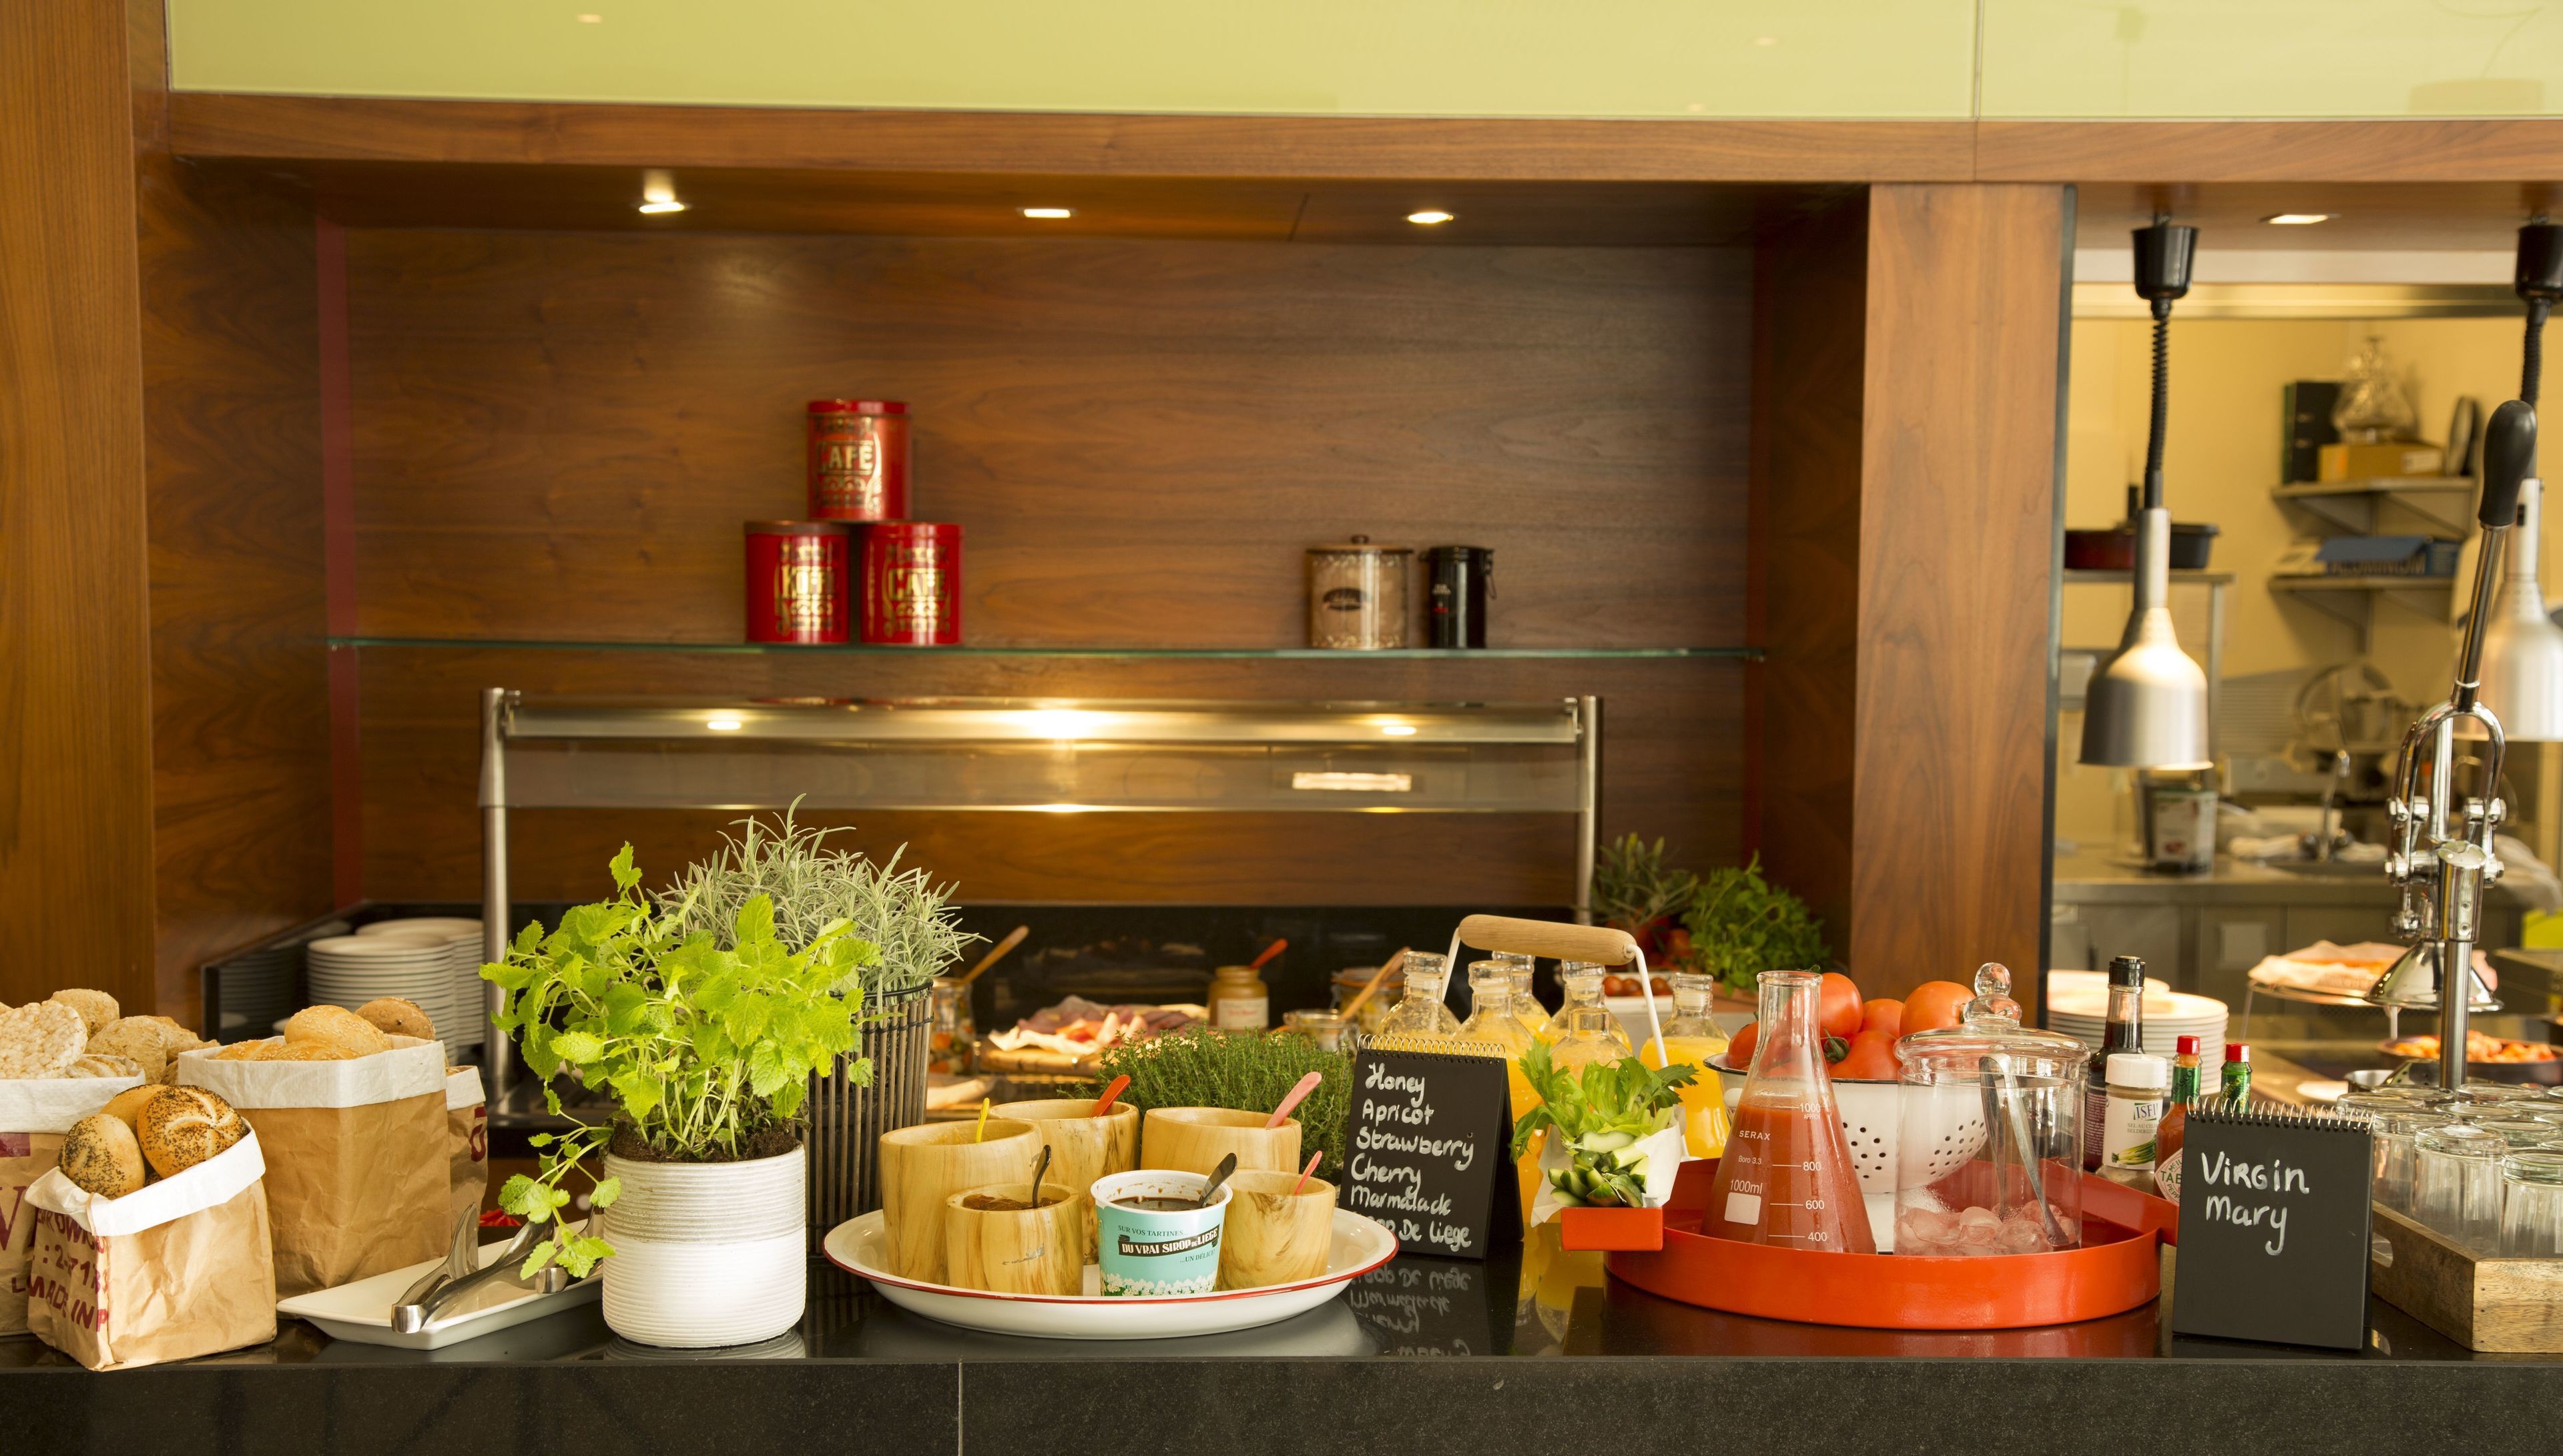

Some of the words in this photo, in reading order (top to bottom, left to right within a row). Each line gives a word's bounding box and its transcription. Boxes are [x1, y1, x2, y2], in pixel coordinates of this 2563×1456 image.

[1365, 1062, 1426, 1108] Honey
[1362, 1098, 1434, 1127] Apricot
[1799, 1102, 1821, 1113] 1000
[1739, 1130, 1771, 1141] SERAX
[1356, 1126, 1474, 1171] Strawberry
[1738, 1156, 1751, 1164] Boro
[1752, 1157, 1763, 1165] 3.3
[1803, 1161, 1821, 1171] 800
[1351, 1152, 1422, 1200] Cherry
[1730, 1179, 1763, 1194] 1000ml
[1805, 1200, 1825, 1210] 600
[1118, 1225, 1131, 1233] SUR
[1398, 1218, 1422, 1242] De
[1122, 1243, 1134, 1254] DU
[1135, 1245, 1160, 1254] VRAI
[1162, 1239, 1191, 1254] SIROP
[1197, 1228, 1218, 1246] LIEGE
[1807, 1232, 1827, 1242] 400
[71, 1299, 95, 1329] IN
